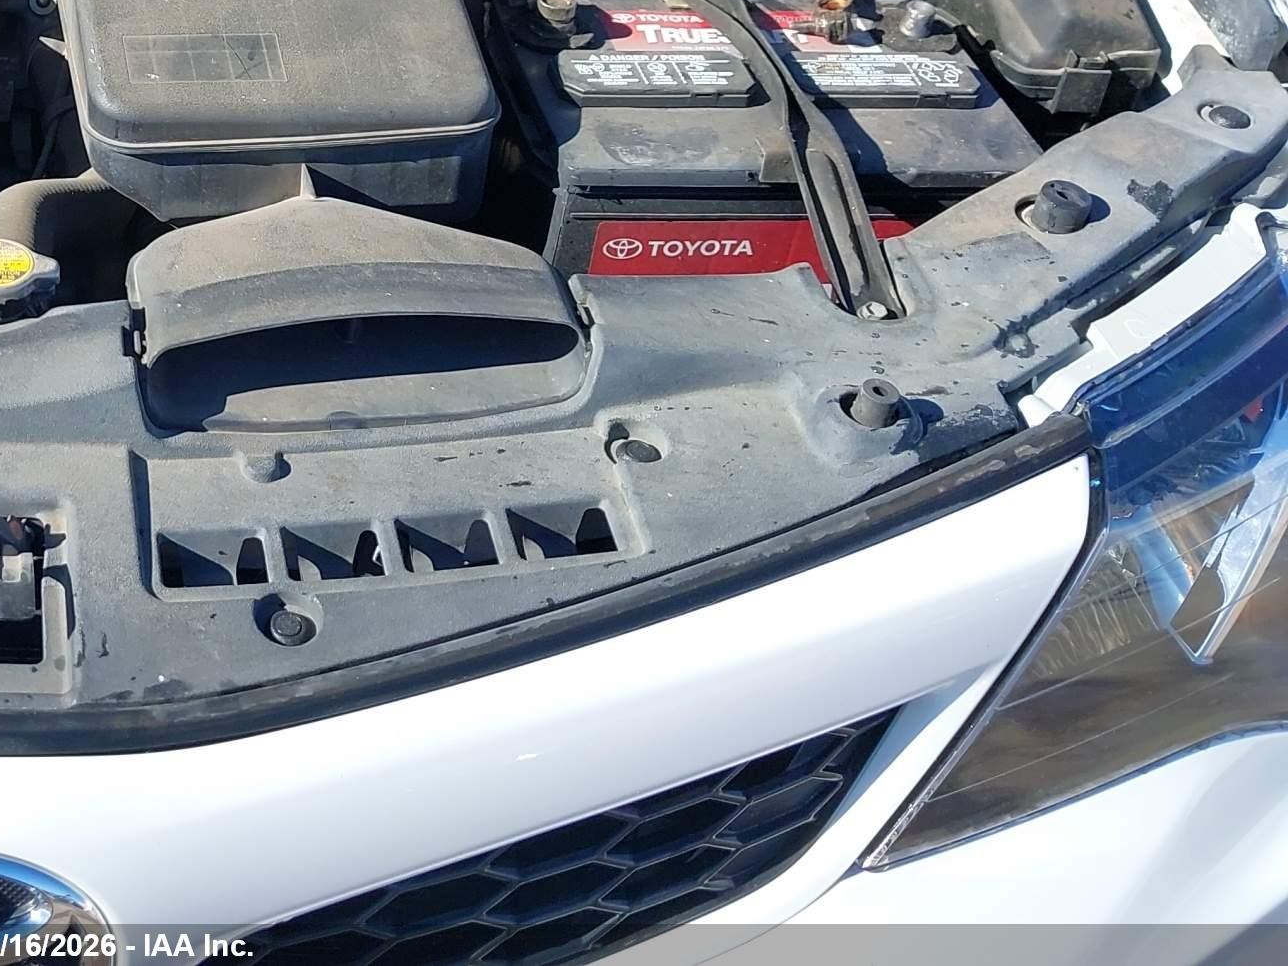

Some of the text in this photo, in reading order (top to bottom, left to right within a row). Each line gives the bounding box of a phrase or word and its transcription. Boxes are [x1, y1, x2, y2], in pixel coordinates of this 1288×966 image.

[635, 13, 705, 23] TOYOTA
[599, 54, 650, 62] DANGER
[660, 54, 705, 62] POISON
[648, 239, 754, 258] TOYOTA
